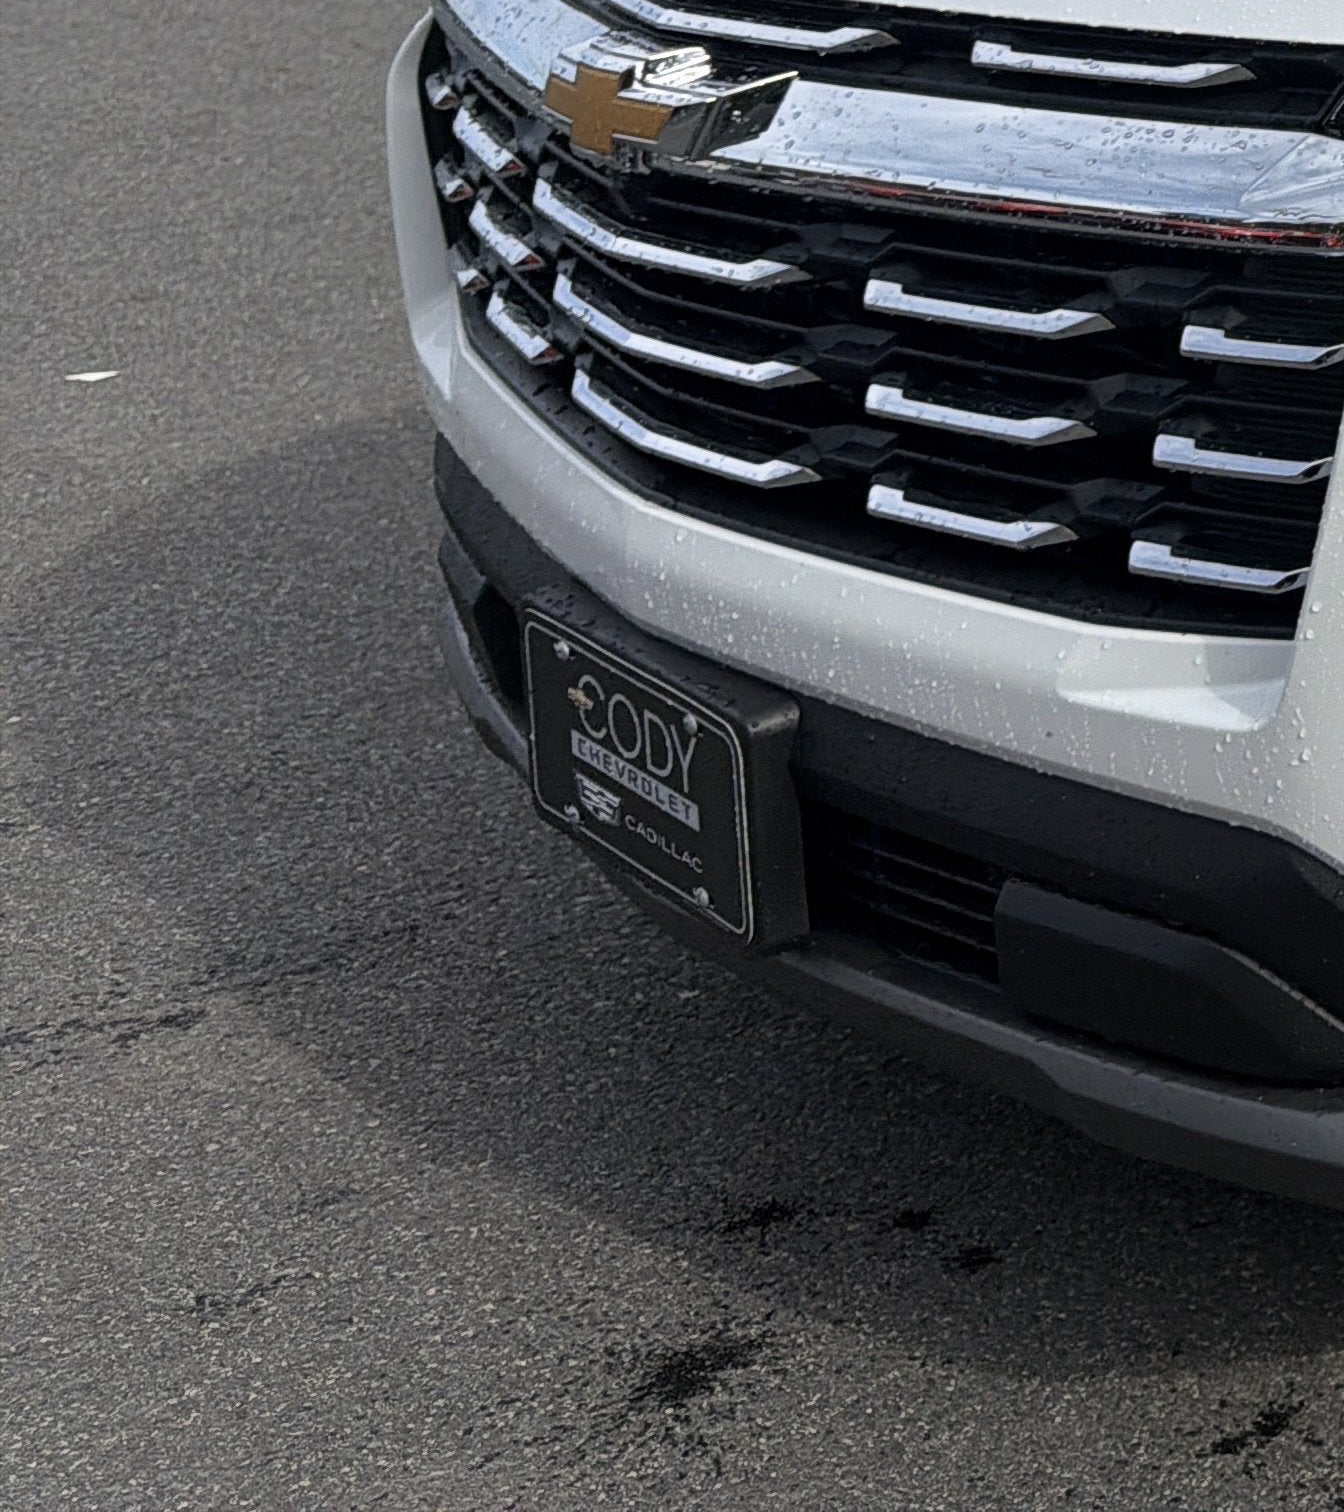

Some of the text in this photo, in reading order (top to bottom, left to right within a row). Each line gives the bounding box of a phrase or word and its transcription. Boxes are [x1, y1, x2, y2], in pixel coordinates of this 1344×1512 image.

[574, 674, 698, 793] CODY
[576, 735, 693, 822] CHEVROLET
[624, 813, 704, 874] CADILLAC
